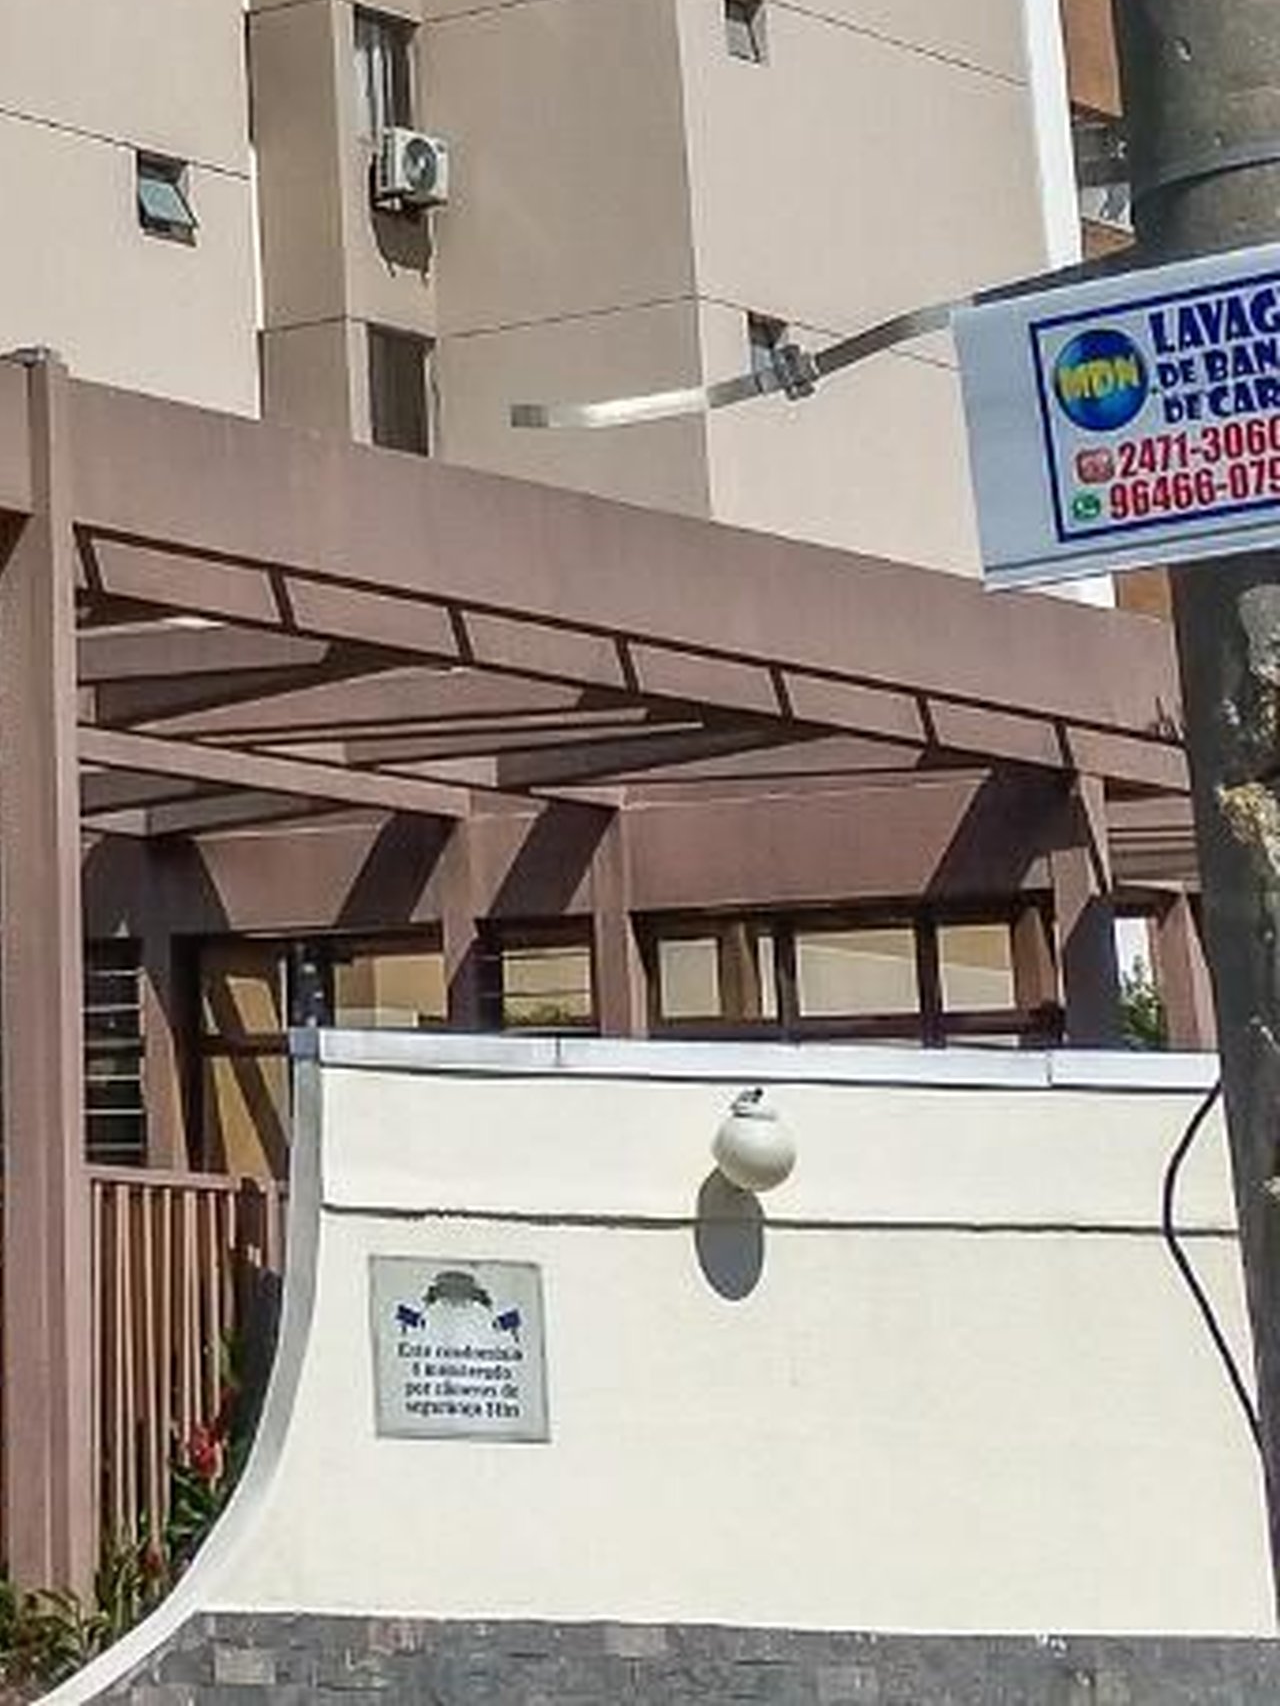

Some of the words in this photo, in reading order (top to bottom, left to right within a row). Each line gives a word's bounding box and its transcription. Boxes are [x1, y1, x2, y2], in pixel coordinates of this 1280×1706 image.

[1157, 357, 1197, 389] DE
[1164, 392, 1202, 424] DE
[1208, 377, 1280, 418] CAR
